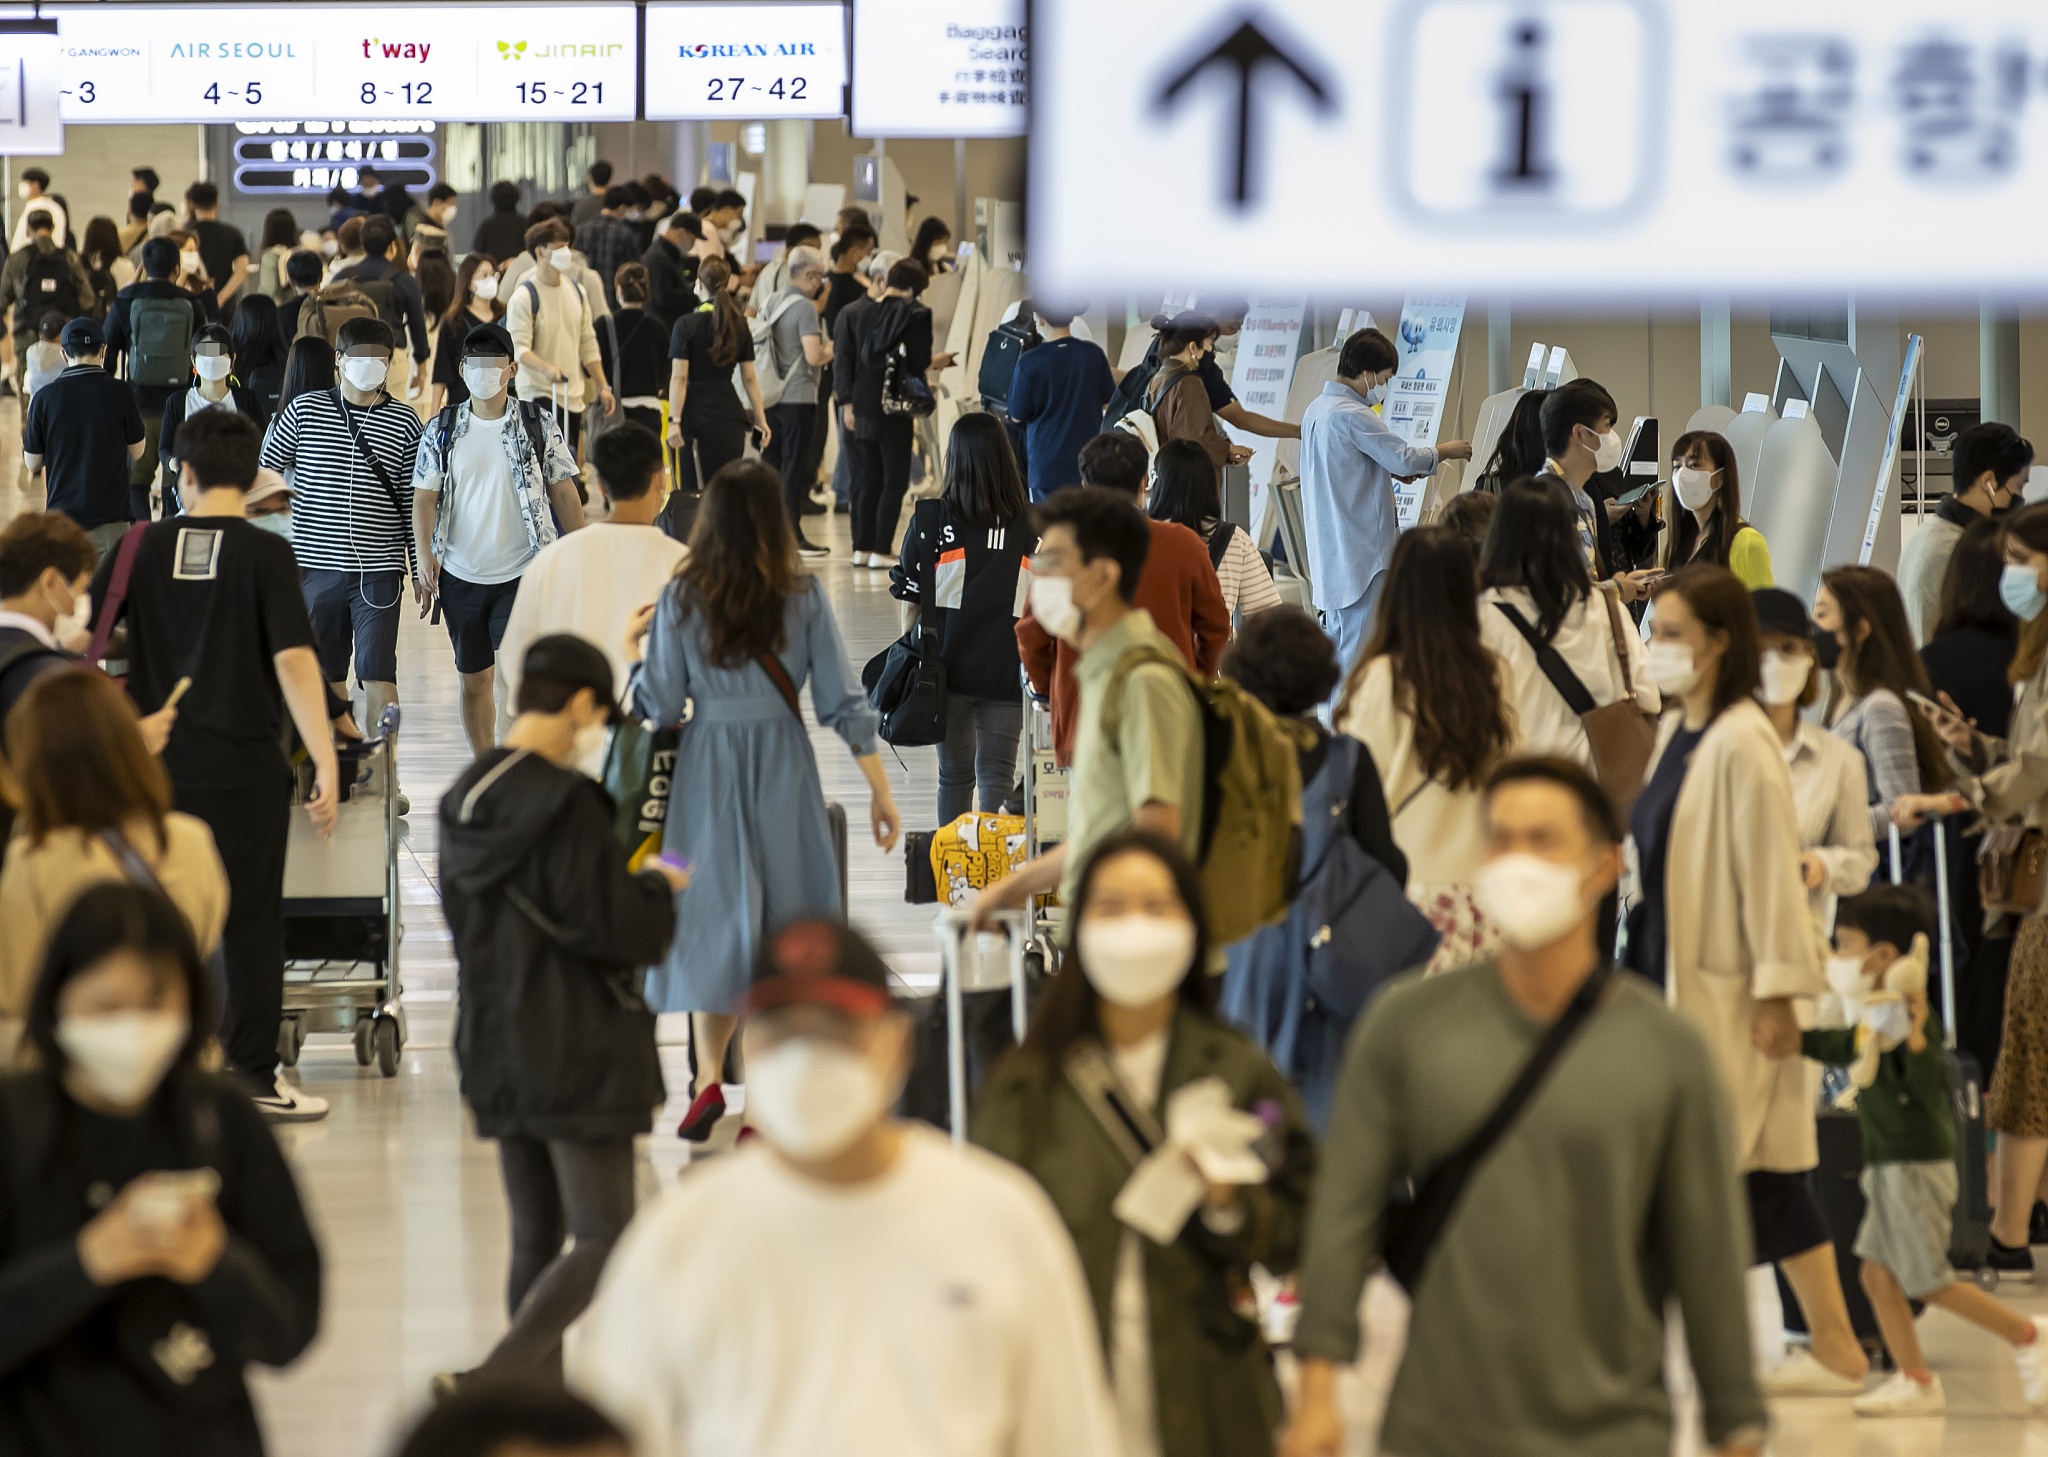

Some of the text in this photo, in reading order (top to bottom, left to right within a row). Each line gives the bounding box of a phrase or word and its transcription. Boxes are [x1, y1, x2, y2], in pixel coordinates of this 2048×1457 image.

[67, 48, 140, 57] GANGWON
[170, 42, 296, 59] AIR SEOUL
[678, 42, 816, 58] KOREAN AIR
